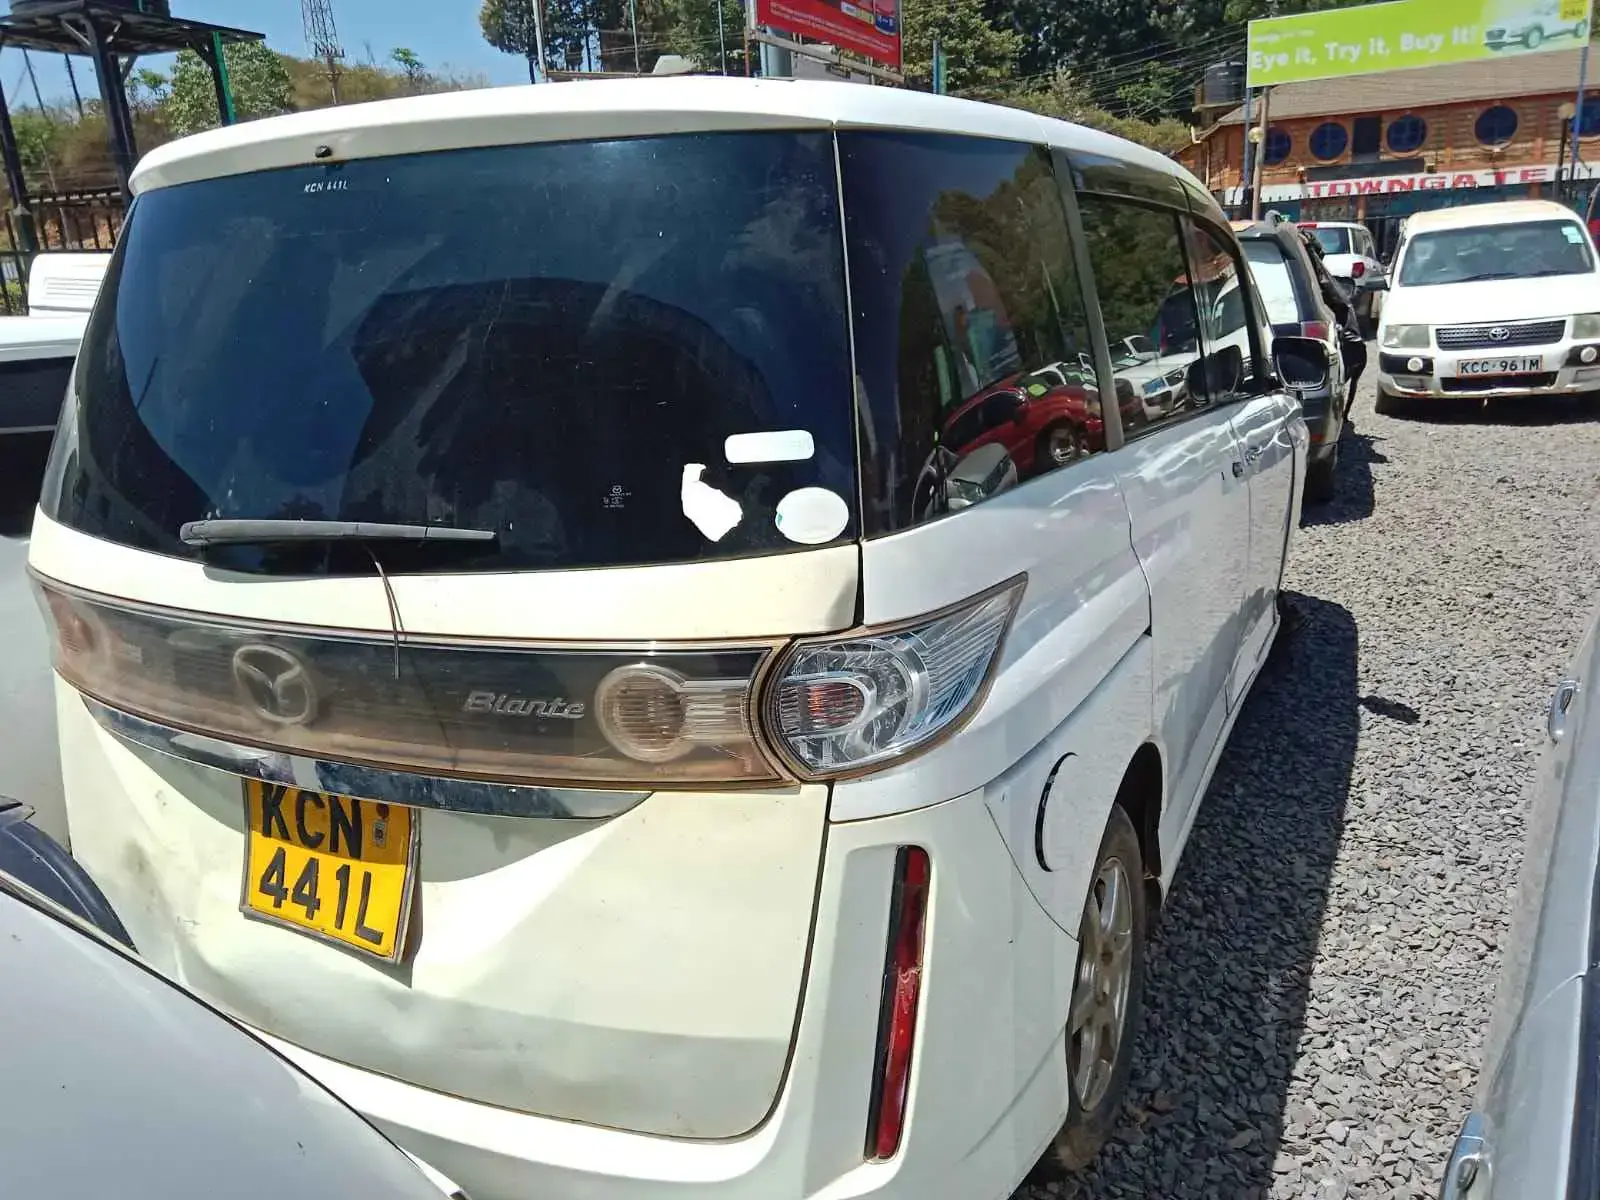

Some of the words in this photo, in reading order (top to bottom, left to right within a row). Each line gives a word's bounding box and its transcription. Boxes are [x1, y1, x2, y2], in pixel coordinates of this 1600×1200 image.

[1250, 50, 1289, 72] Eye
[1324, 41, 1362, 63] Try
[1400, 32, 1444, 54] Buy
[303, 182, 324, 193] KCN
[1308, 168, 1548, 197] TOWNGATE
[1460, 361, 1489, 374] KCC
[1499, 359, 1539, 372] 961M
[463, 690, 585, 719] Biante
[260, 783, 363, 861] KCN
[258, 846, 384, 945] 441L
